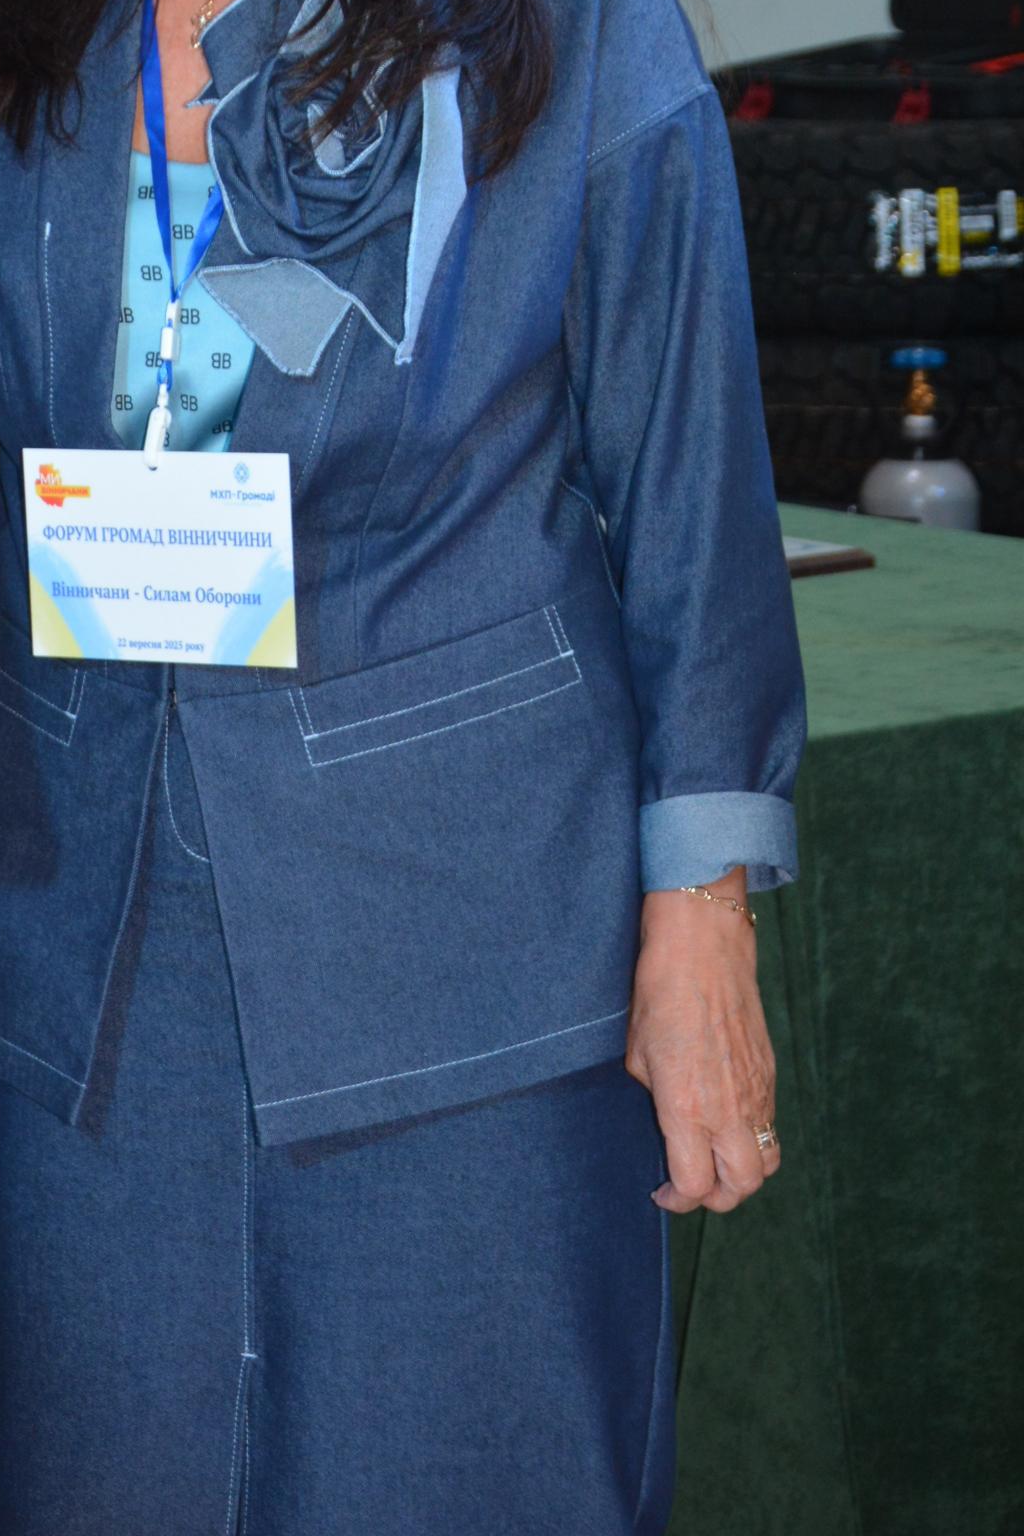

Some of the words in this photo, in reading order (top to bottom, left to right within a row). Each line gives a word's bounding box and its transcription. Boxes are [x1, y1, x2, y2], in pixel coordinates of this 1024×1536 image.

[42, 525, 98, 543] ФОРУМ
[101, 526, 165, 546] ГРОМАД
[168, 530, 273, 548] ВІННИЧЧИНИ
[51, 582, 130, 600] Вінничани
[143, 585, 191, 602] Силам
[195, 587, 262, 607] Оборони
[129, 639, 162, 650] вересня
[164, 639, 183, 650] 2025
[185, 642, 204, 653] року
